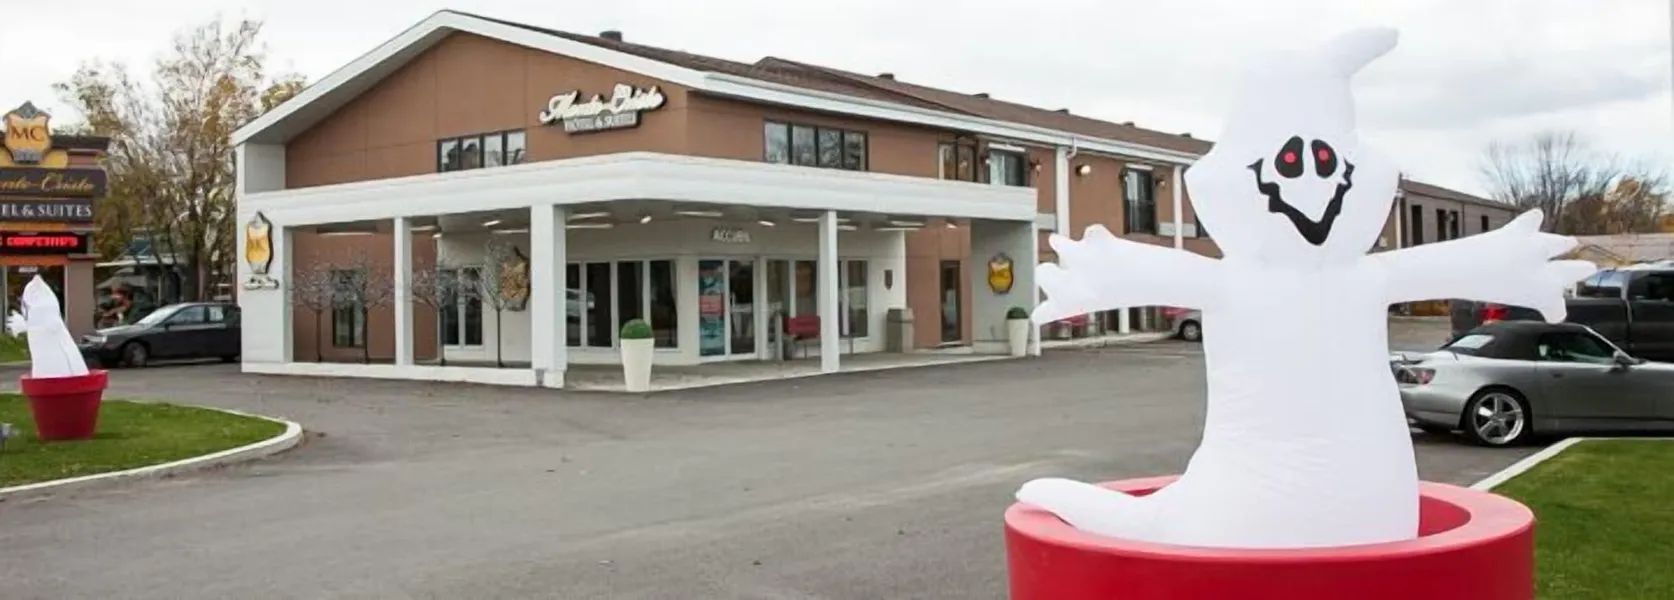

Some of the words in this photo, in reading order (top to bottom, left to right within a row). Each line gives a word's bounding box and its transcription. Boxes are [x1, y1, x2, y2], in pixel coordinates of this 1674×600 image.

[10, 126, 45, 142] MC
[21, 203, 35, 217] &
[37, 203, 92, 217] SUITES
